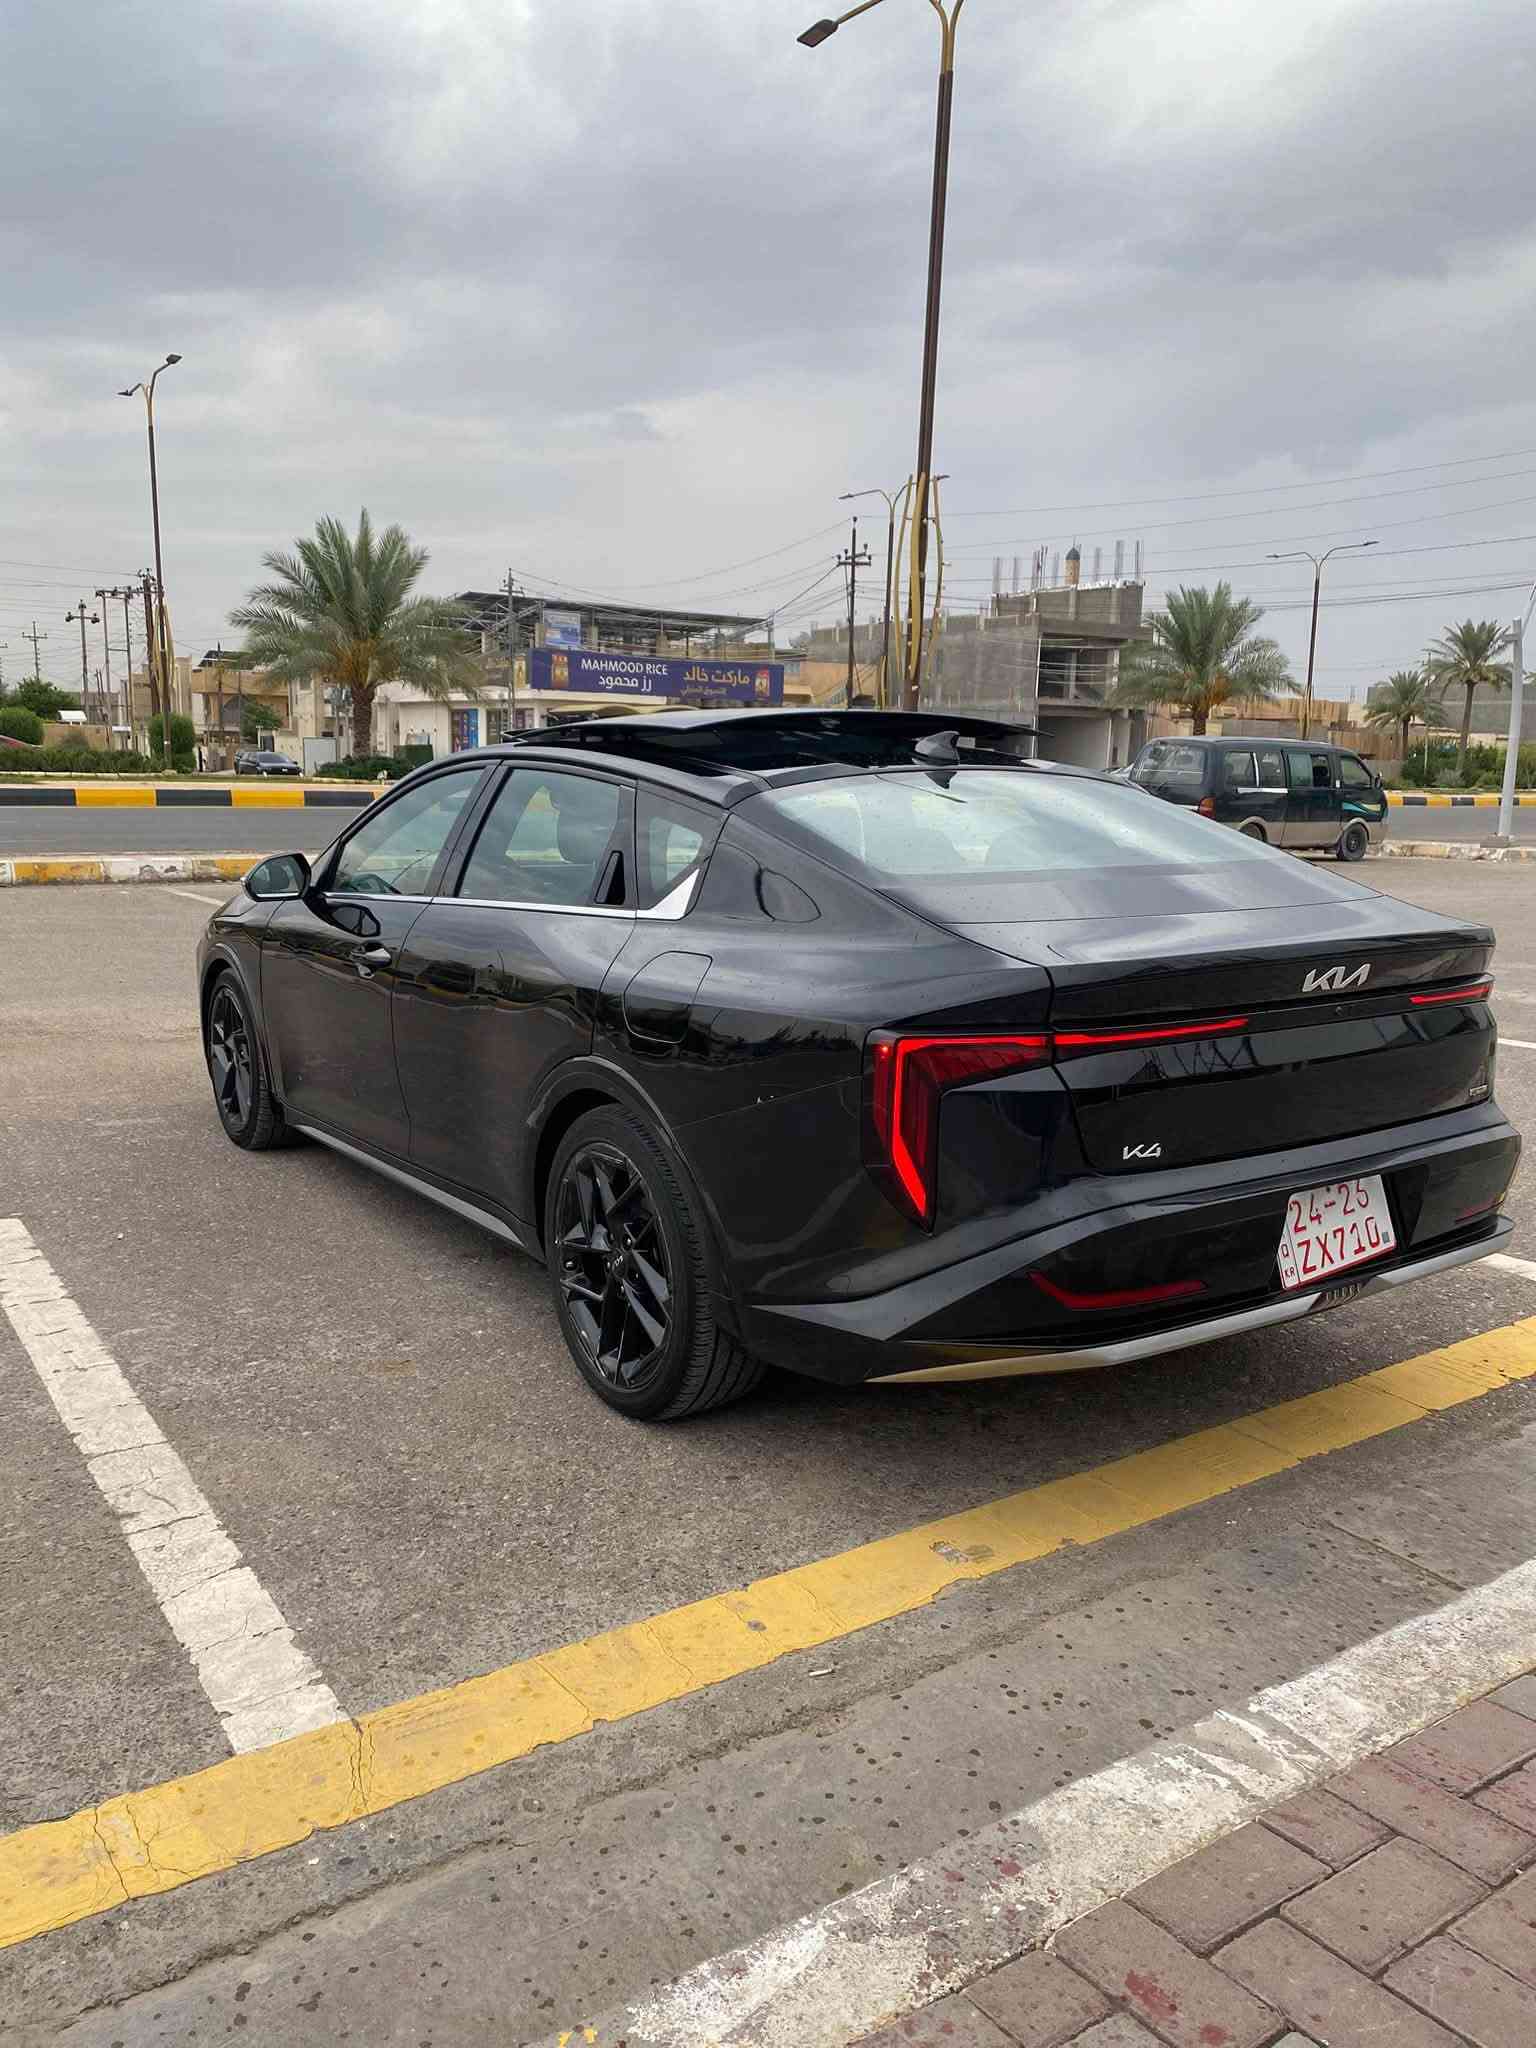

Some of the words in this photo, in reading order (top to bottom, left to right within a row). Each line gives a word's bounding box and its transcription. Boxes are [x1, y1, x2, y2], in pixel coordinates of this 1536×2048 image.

[581, 658, 643, 674] MAHMOOD
[646, 663, 669, 675] RICE
[683, 665, 709, 682] خالد
[598, 676, 639, 689] محمود
[641, 675, 652, 692] رز
[712, 668, 751, 687] ماركت
[1302, 963, 1371, 992] KIA
[1122, 1142, 1161, 1160] K4
[1297, 1216, 1381, 1275] ZX710
